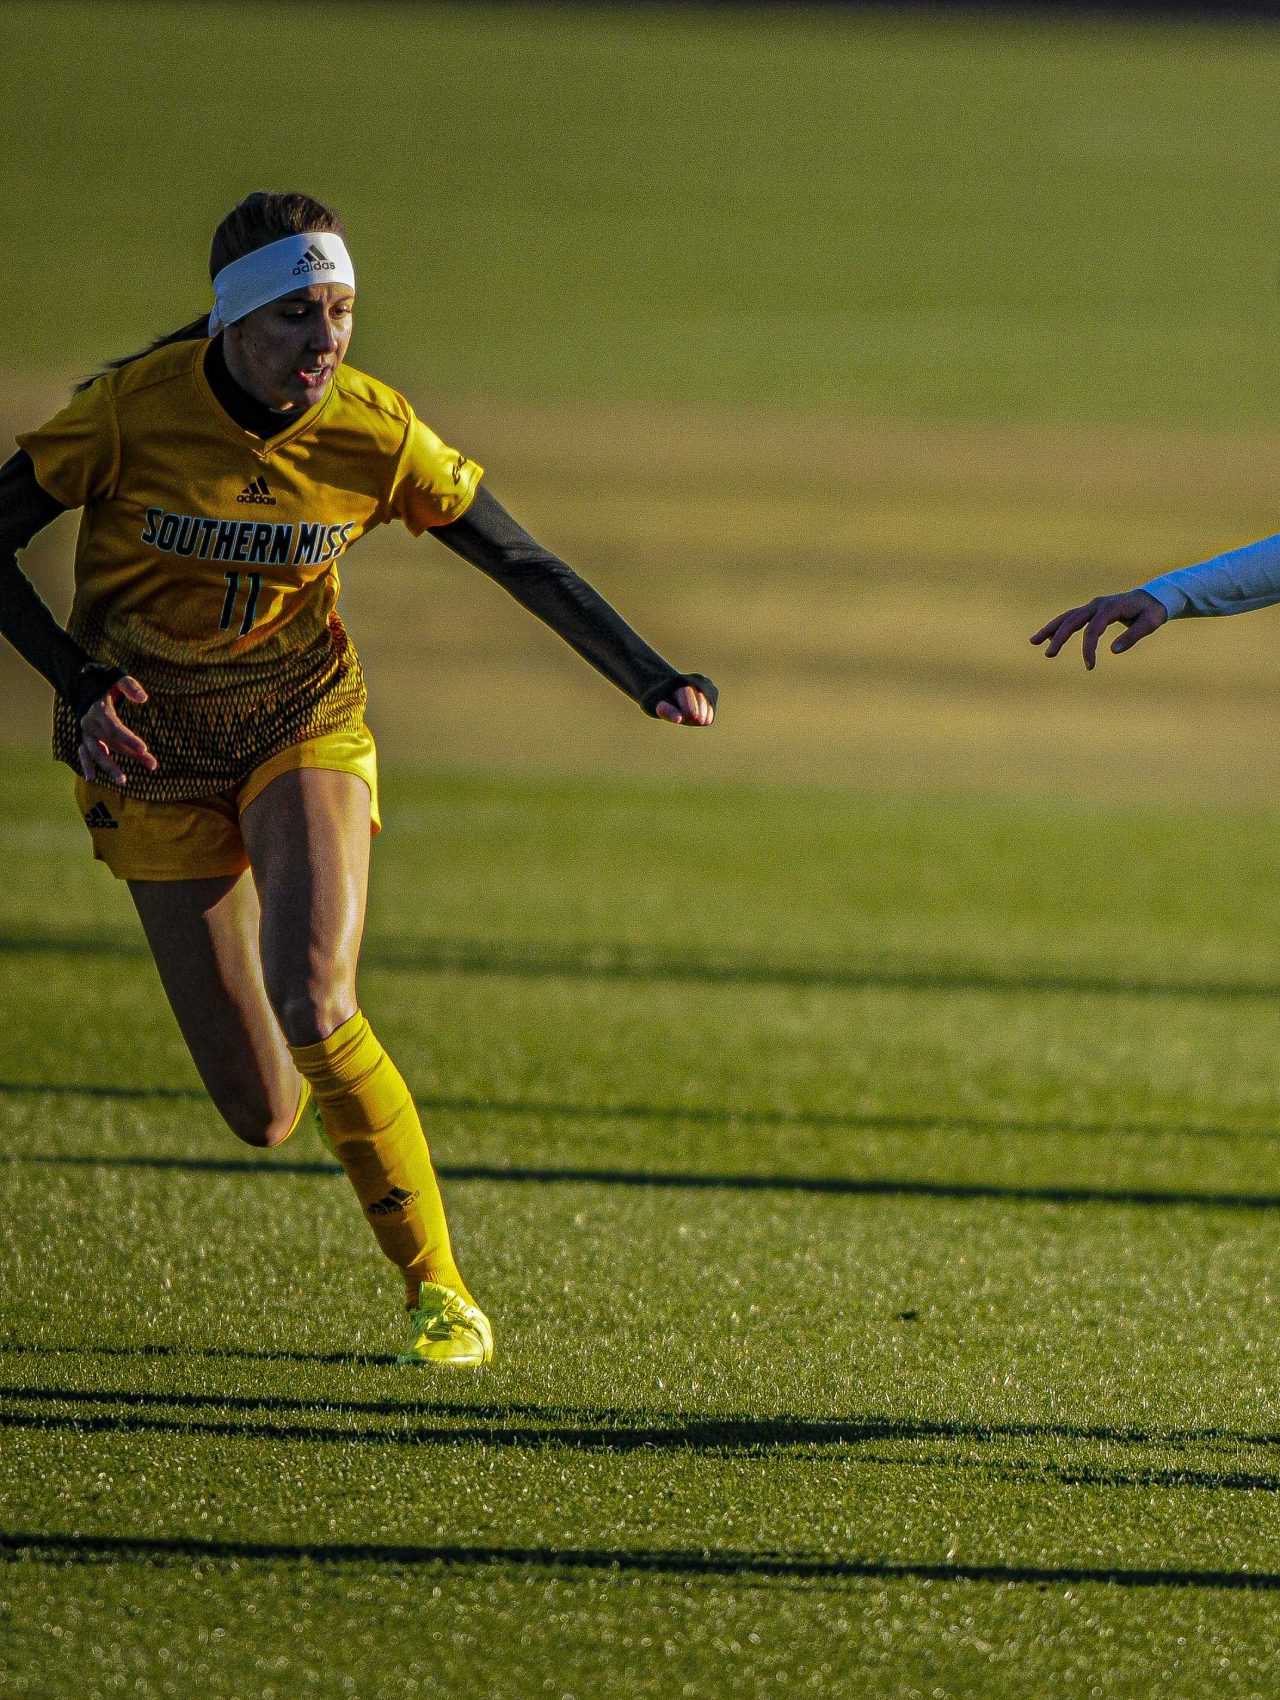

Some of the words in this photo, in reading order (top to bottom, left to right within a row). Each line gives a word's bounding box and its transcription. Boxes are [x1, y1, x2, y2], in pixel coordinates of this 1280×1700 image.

[292, 259, 336, 276] adidas
[236, 494, 276, 506] adidas
[140, 506, 294, 565] SOUTHERN
[292, 520, 356, 567] MISS
[218, 571, 264, 636] 11
